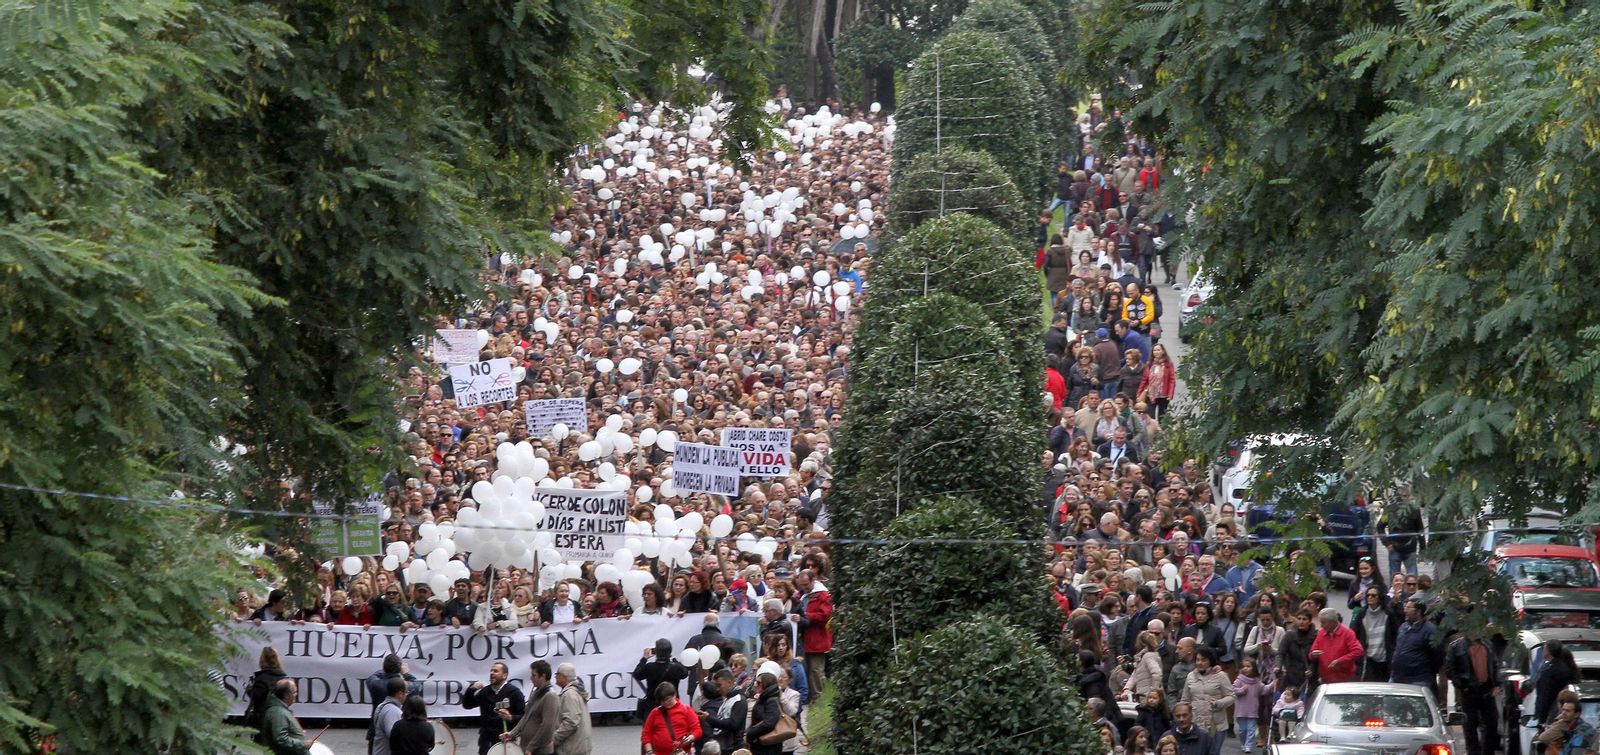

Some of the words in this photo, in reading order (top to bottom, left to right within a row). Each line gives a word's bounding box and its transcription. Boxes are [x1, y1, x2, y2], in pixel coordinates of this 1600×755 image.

[469, 361, 491, 377] NO
[457, 395, 463, 407] A
[465, 392, 478, 406] LOS
[480, 386, 515, 404] RECORTES
[674, 444, 700, 464] HUNDEN
[702, 447, 711, 465] LA
[713, 448, 739, 468] PUBLICA
[760, 444, 775, 452] VA
[743, 452, 786, 466] VIDA
[749, 466, 781, 474] ELLO
[674, 470, 703, 491] FAVORECEN
[705, 473, 712, 491] LA
[714, 475, 736, 494] PRIVADA
[567, 497, 582, 512] DE
[583, 497, 626, 516] COLON
[547, 512, 574, 531] DÍAS
[579, 518, 595, 533] EN
[352, 540, 372, 548] ELENA
[555, 533, 605, 550] ESPERA
[285, 629, 433, 666] HUELVA,
[444, 633, 519, 662] POR
[528, 627, 604, 659] UNA
